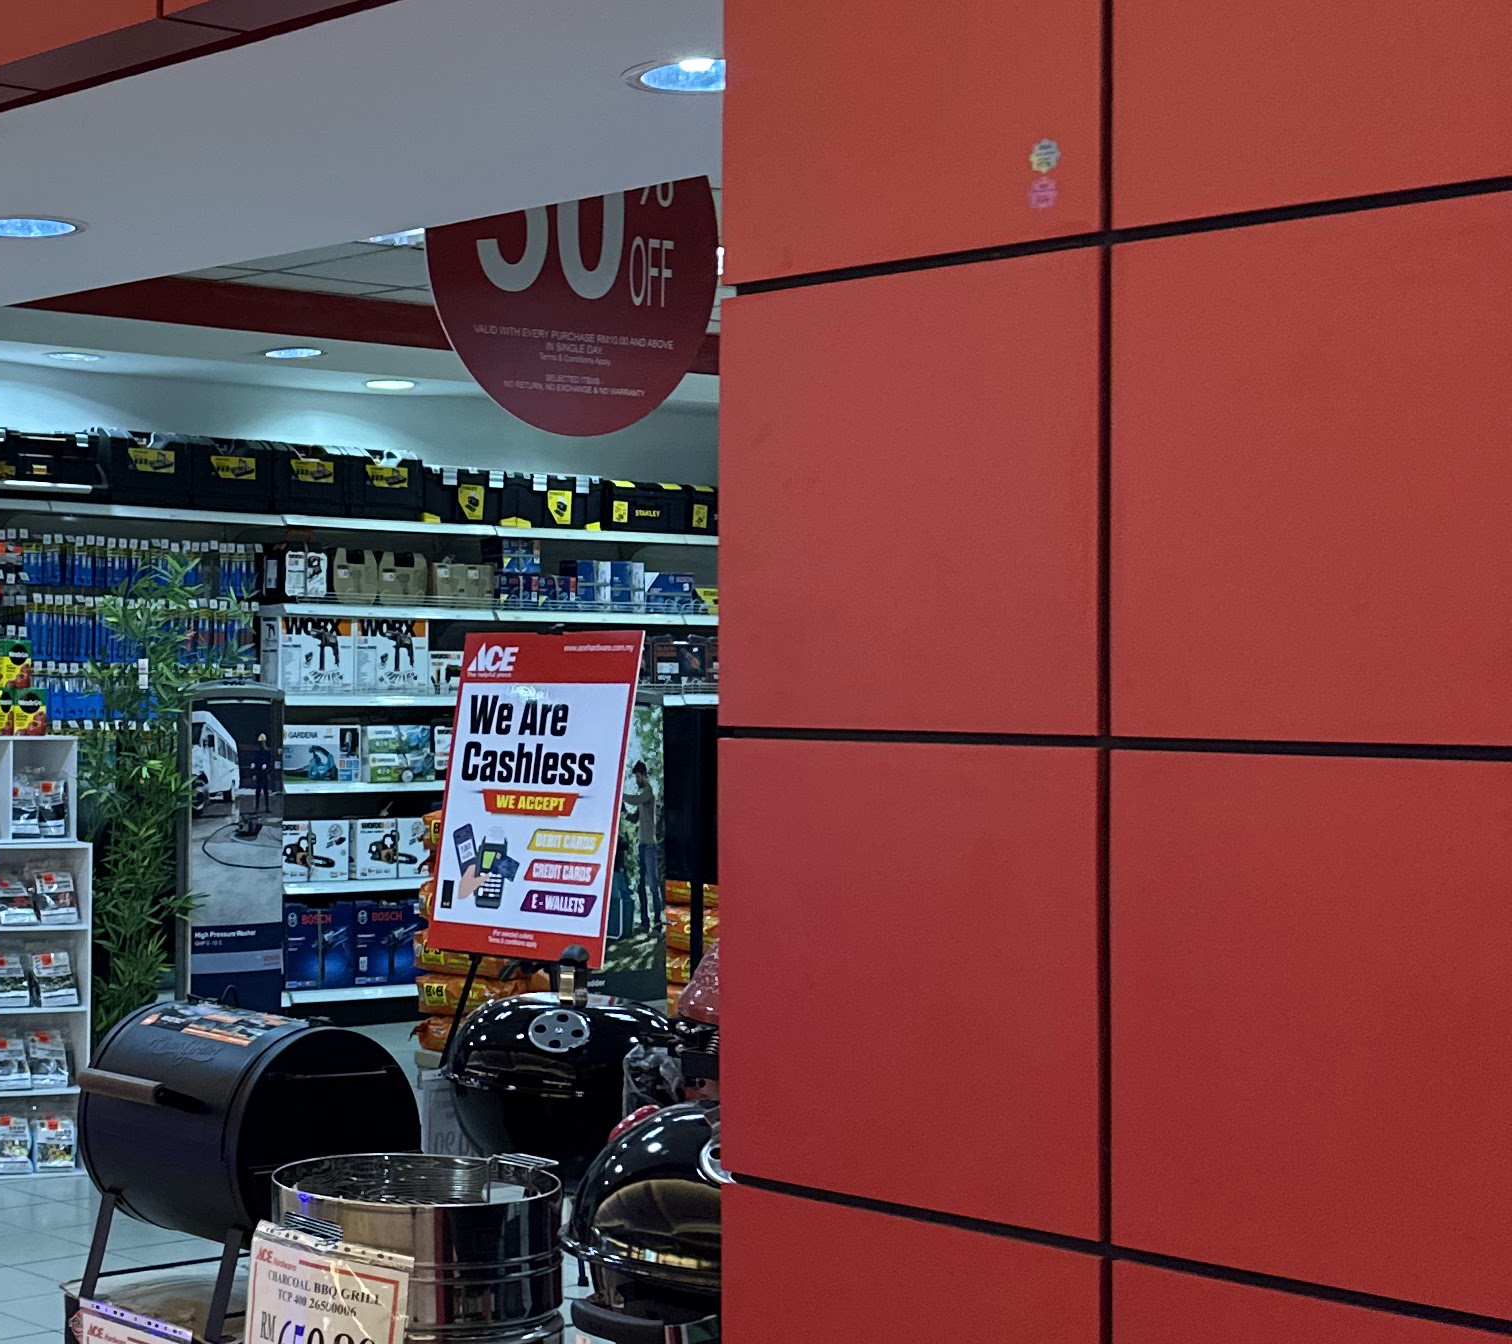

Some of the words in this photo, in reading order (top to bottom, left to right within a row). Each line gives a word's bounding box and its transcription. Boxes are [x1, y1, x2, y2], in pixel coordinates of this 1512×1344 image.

[629, 235, 676, 308] OFF
[473, 324, 497, 335] VALID
[498, 326, 521, 337] WITH
[521, 327, 550, 339] EVERY
[551, 330, 595, 343] PURCHASE
[647, 339, 675, 351] ABOVE
[555, 342, 586, 354] SINGLE
[467, 642, 520, 672] ACE
[470, 694, 514, 735] We
[518, 699, 570, 737] Are
[461, 741, 595, 787] Cashless
[496, 795, 516, 810] WE
[517, 796, 566, 812] ACCEPT
[532, 862, 563, 880] CREDIT
[562, 864, 592, 883] CARDS
[545, 894, 586, 914] WALLETS
[371, 911, 403, 922] BOSCH
[256, 1246, 274, 1264] ACE
[268, 1269, 311, 1292] CHARCOAL
[314, 1282, 338, 1299] BBQ
[341, 1288, 383, 1307] GRILL
[278, 1288, 293, 1303] TCP
[87, 1323, 104, 1339] ACE
[260, 1311, 276, 1343] RM
